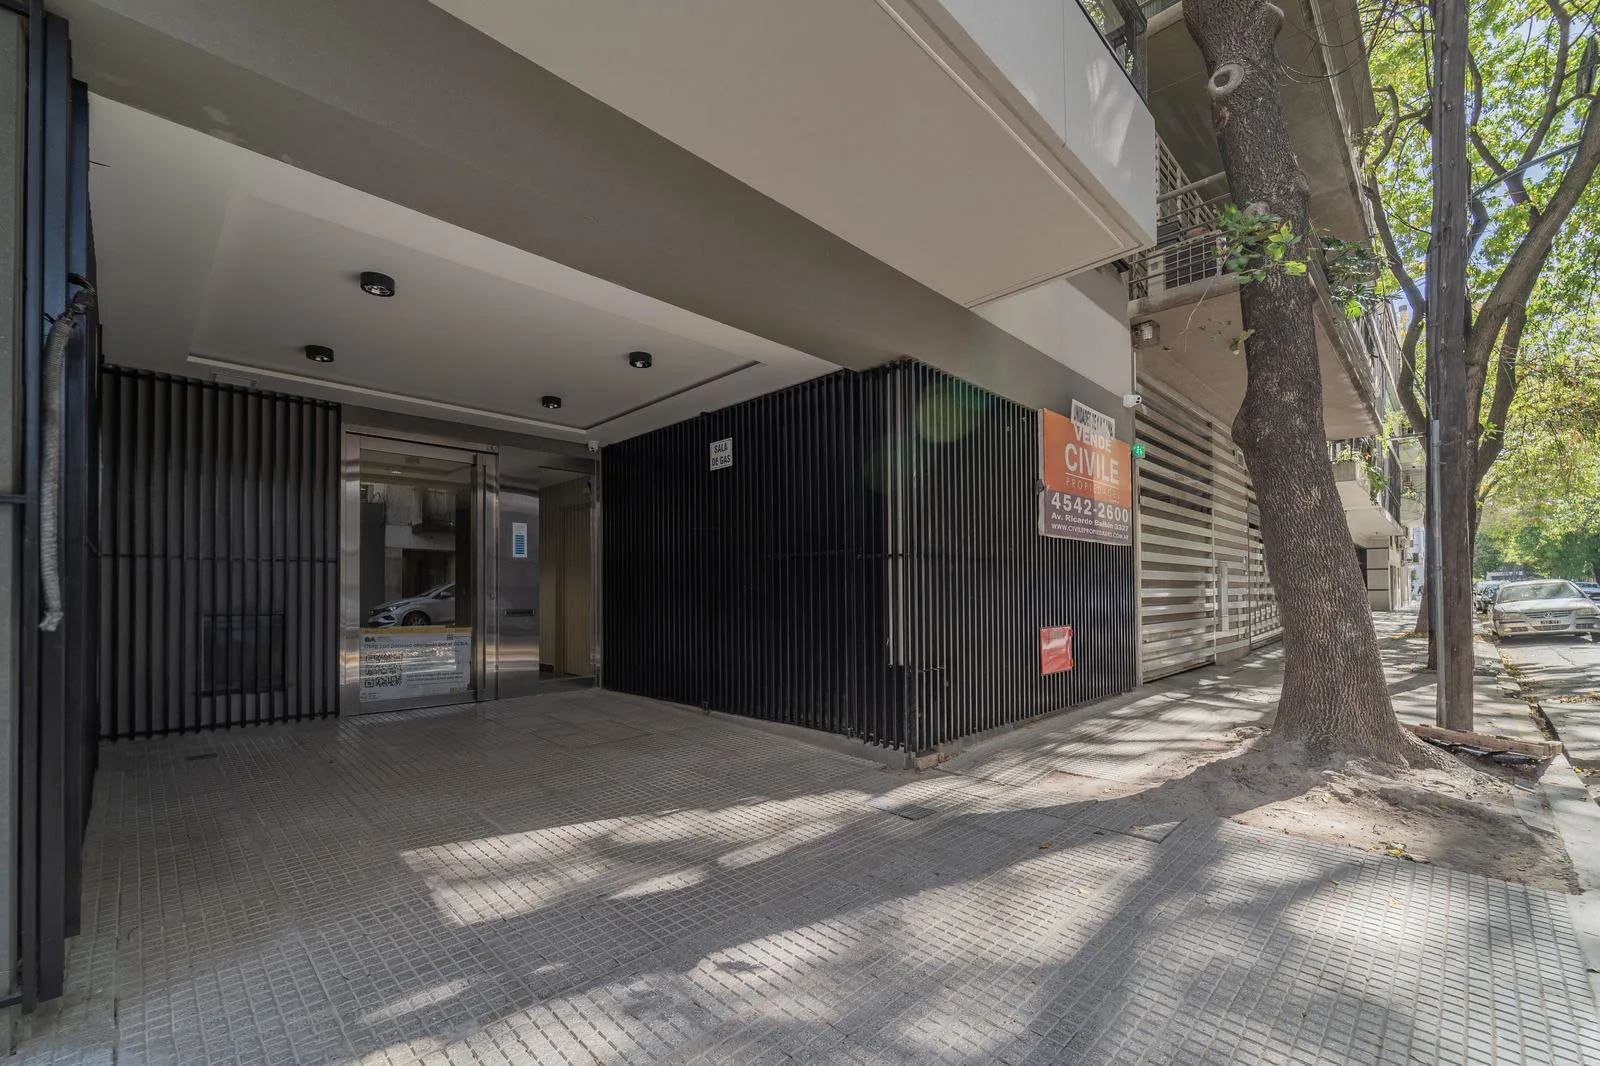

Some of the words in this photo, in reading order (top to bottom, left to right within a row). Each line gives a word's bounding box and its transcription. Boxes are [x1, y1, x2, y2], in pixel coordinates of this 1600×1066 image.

[714, 442, 728, 453] SALA
[1074, 424, 1112, 453] VENDE
[712, 457, 719, 466] DE
[719, 454, 731, 464] GAS
[1064, 443, 1120, 485] CIVILE
[1065, 478, 1120, 500] PROPIEDADES
[1051, 492, 1128, 523] 4542-2600
[1051, 512, 1064, 521] Av.
[1065, 515, 1093, 526] Ricardo
